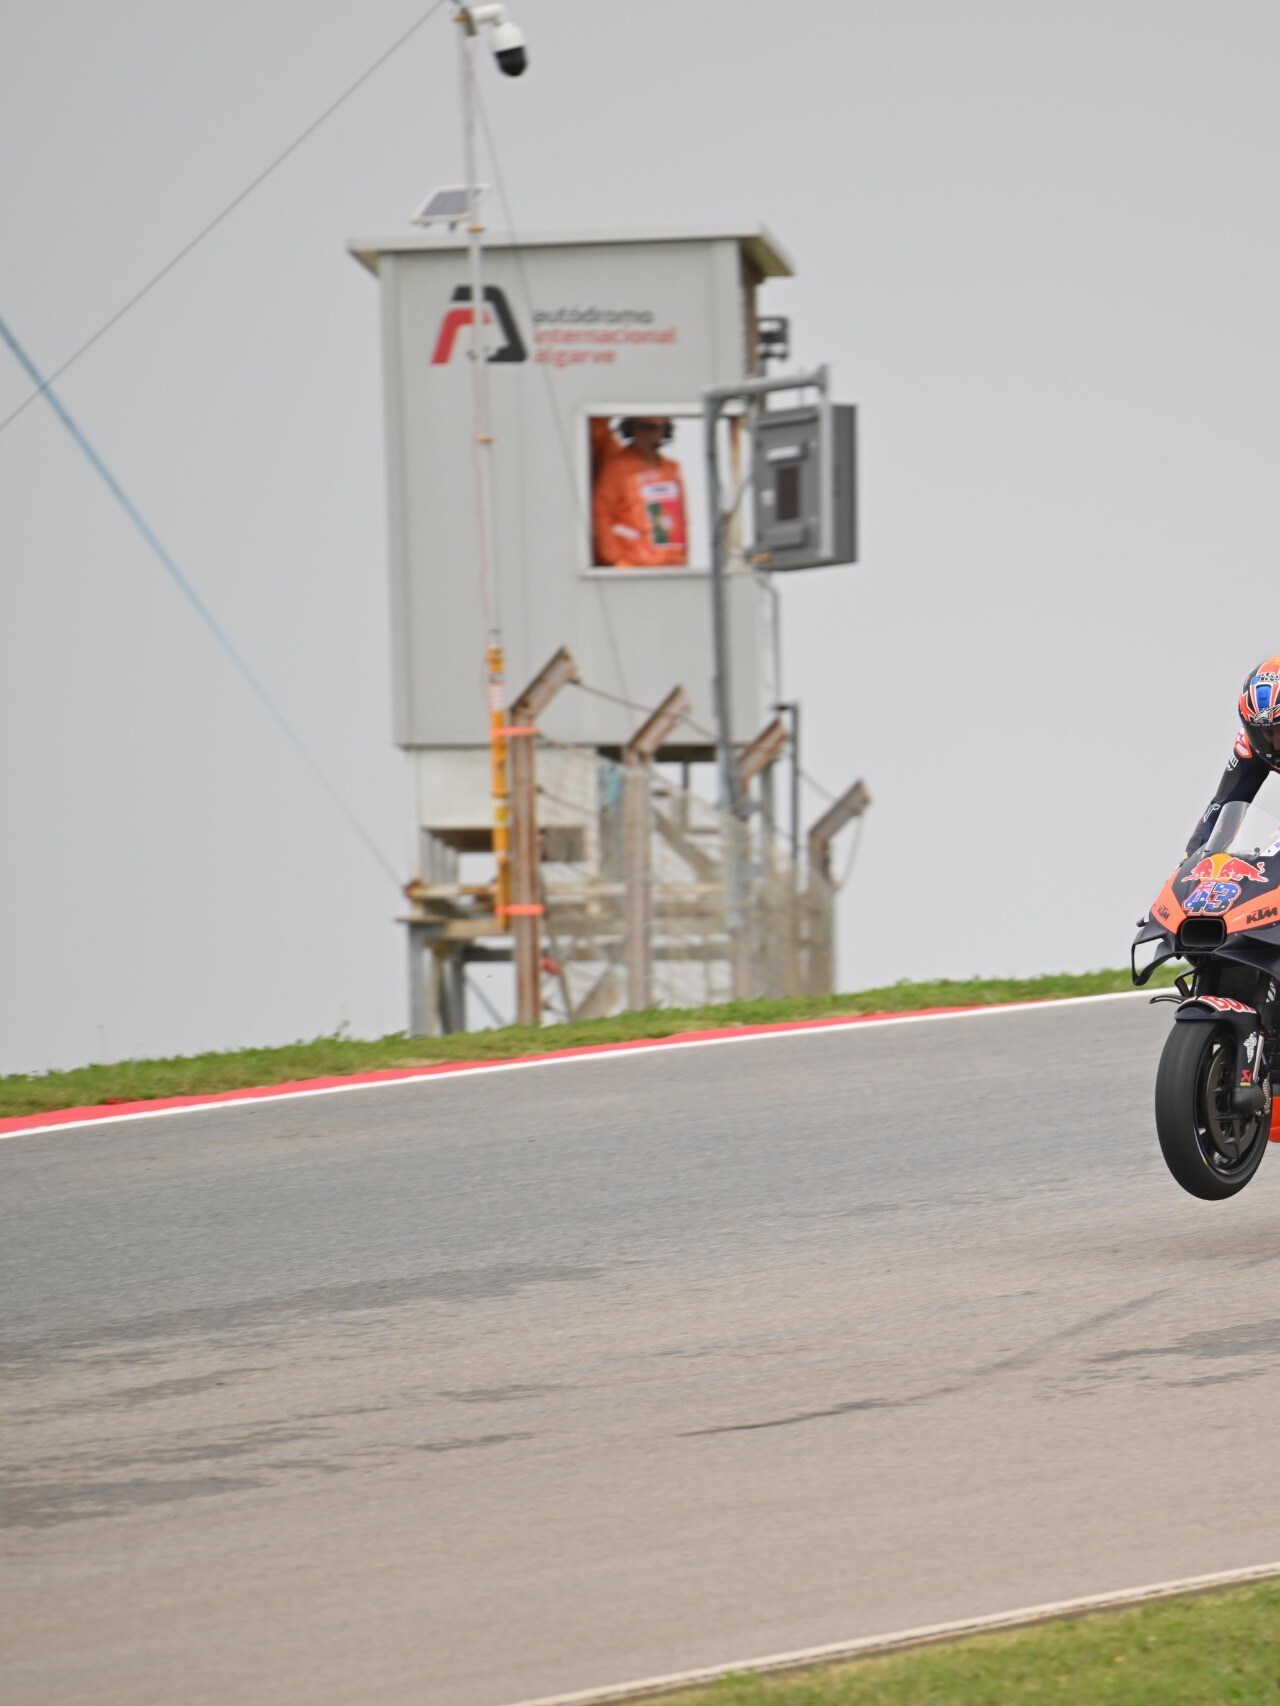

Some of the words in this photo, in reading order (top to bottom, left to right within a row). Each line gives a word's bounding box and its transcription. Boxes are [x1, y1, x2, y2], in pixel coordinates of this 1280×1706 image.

[534, 326, 678, 344] internacional
[534, 348, 615, 369] algarve
[1183, 881, 1242, 917] 43
[1156, 904, 1171, 921] KTM
[1245, 906, 1279, 925] KTM
